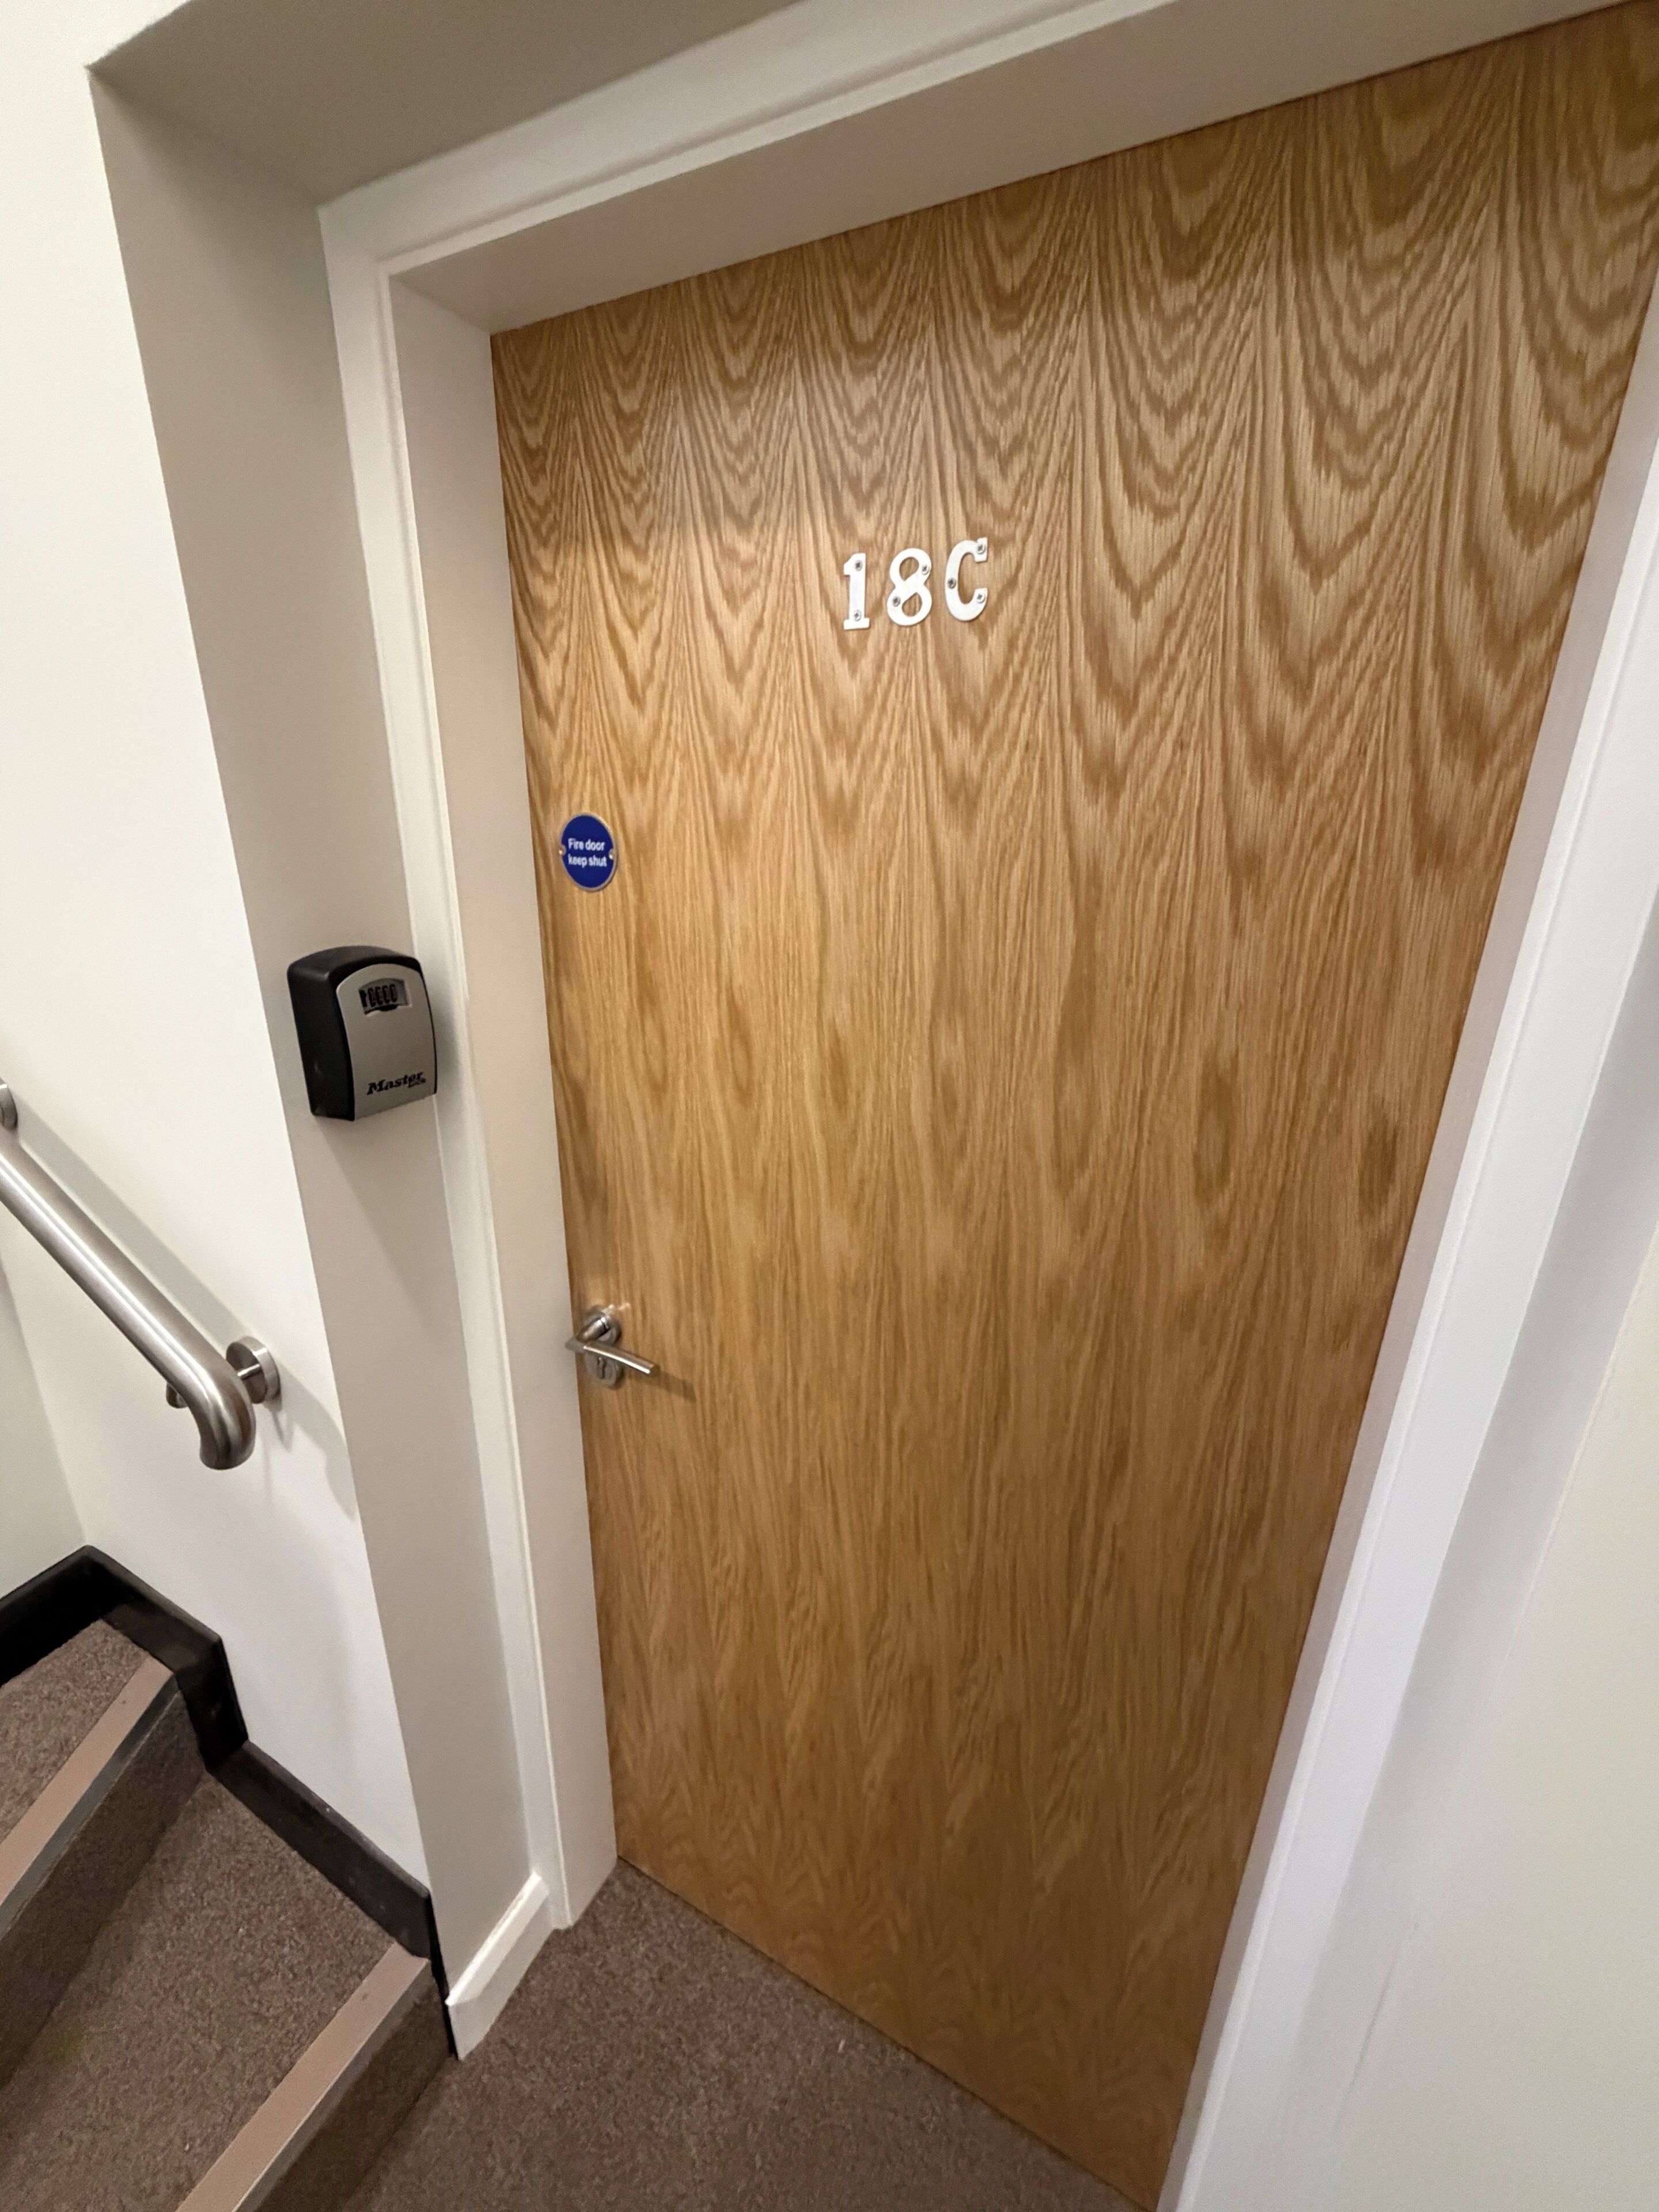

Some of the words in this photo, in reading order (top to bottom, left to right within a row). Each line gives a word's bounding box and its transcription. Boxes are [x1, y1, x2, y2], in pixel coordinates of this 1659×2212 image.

[843, 537, 988, 630] 18C
[568, 838, 584, 850] Fire
[585, 839, 605, 851] door
[567, 853, 588, 868] keep
[588, 855, 607, 867] shut
[367, 1072, 423, 1095] Master
